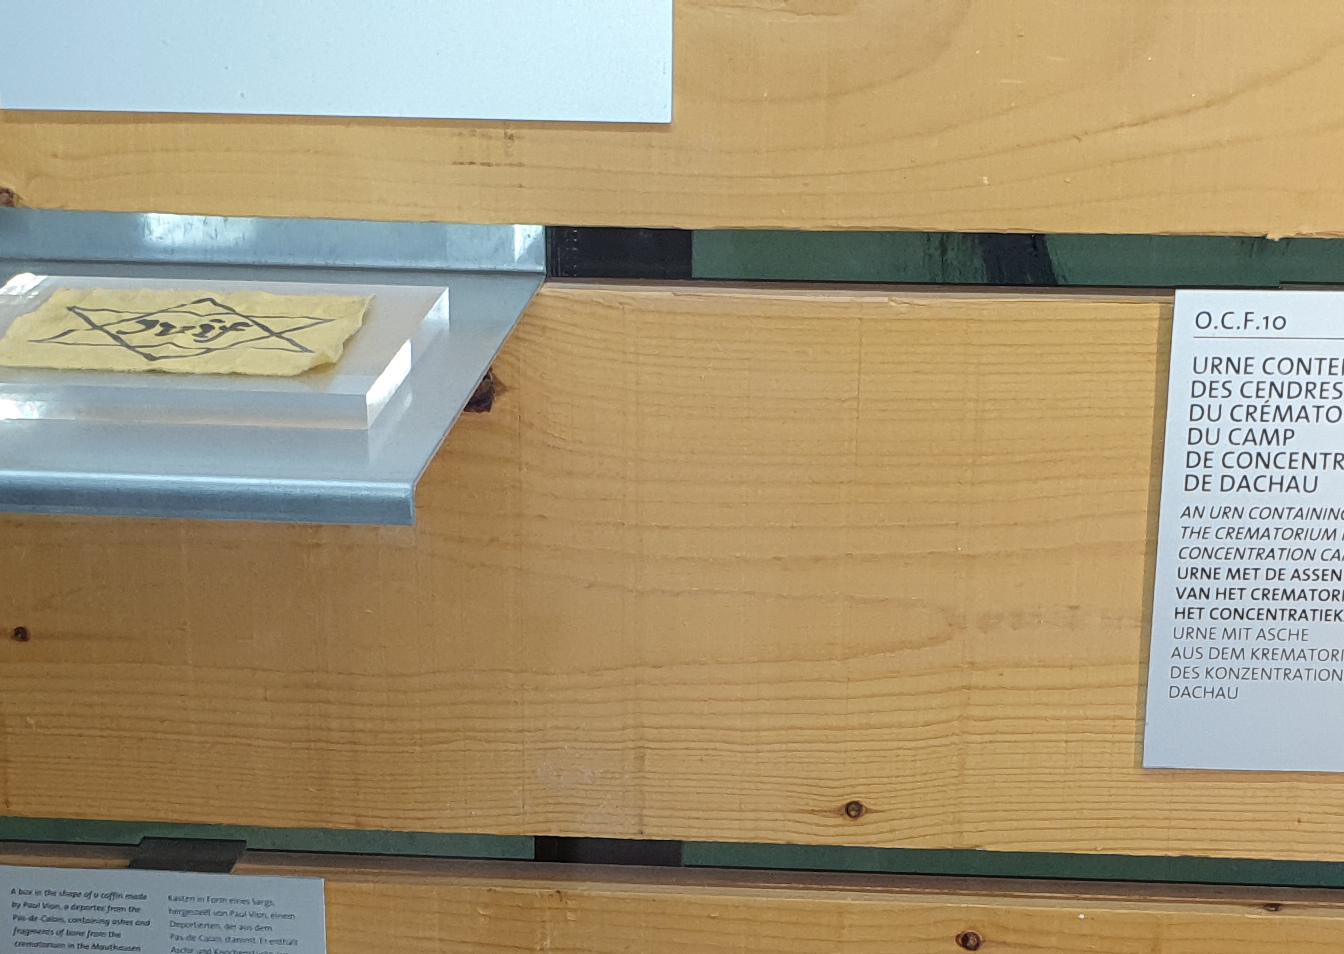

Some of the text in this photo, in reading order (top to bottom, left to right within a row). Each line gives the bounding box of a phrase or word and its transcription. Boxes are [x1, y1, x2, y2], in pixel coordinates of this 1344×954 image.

[1196, 312, 1287, 330] O.C.F.10
[1193, 357, 1255, 375] URNE
[1191, 380, 1232, 399] DES
[1240, 381, 1343, 402] CENDRES
[1190, 404, 1222, 422] DU
[1188, 428, 1295, 446] DU CAMP
[1186, 451, 1214, 469] DE
[1184, 474, 1318, 493] DE DACHAU
[1180, 506, 1206, 519] AN
[1210, 506, 1245, 520] URN
[1181, 526, 1212, 540] THE
[1215, 527, 1337, 541] CREMATORIUM
[1179, 547, 1317, 561] CONCENTRATION
[1178, 567, 1221, 580] URNE
[1226, 568, 1261, 581] MET
[1266, 568, 1286, 581] DE
[1290, 569, 1342, 582] ASSEN
[1176, 587, 1211, 600] VAN
[1216, 588, 1247, 601] HET
[1175, 607, 1205, 620] HET
[1174, 627, 1309, 642] URNE MIT ASCHE
[1171, 647, 1203, 660] AUS
[1209, 647, 1245, 661] DEM
[1171, 666, 1200, 680] DES
[1169, 686, 1239, 700] DACHAU
